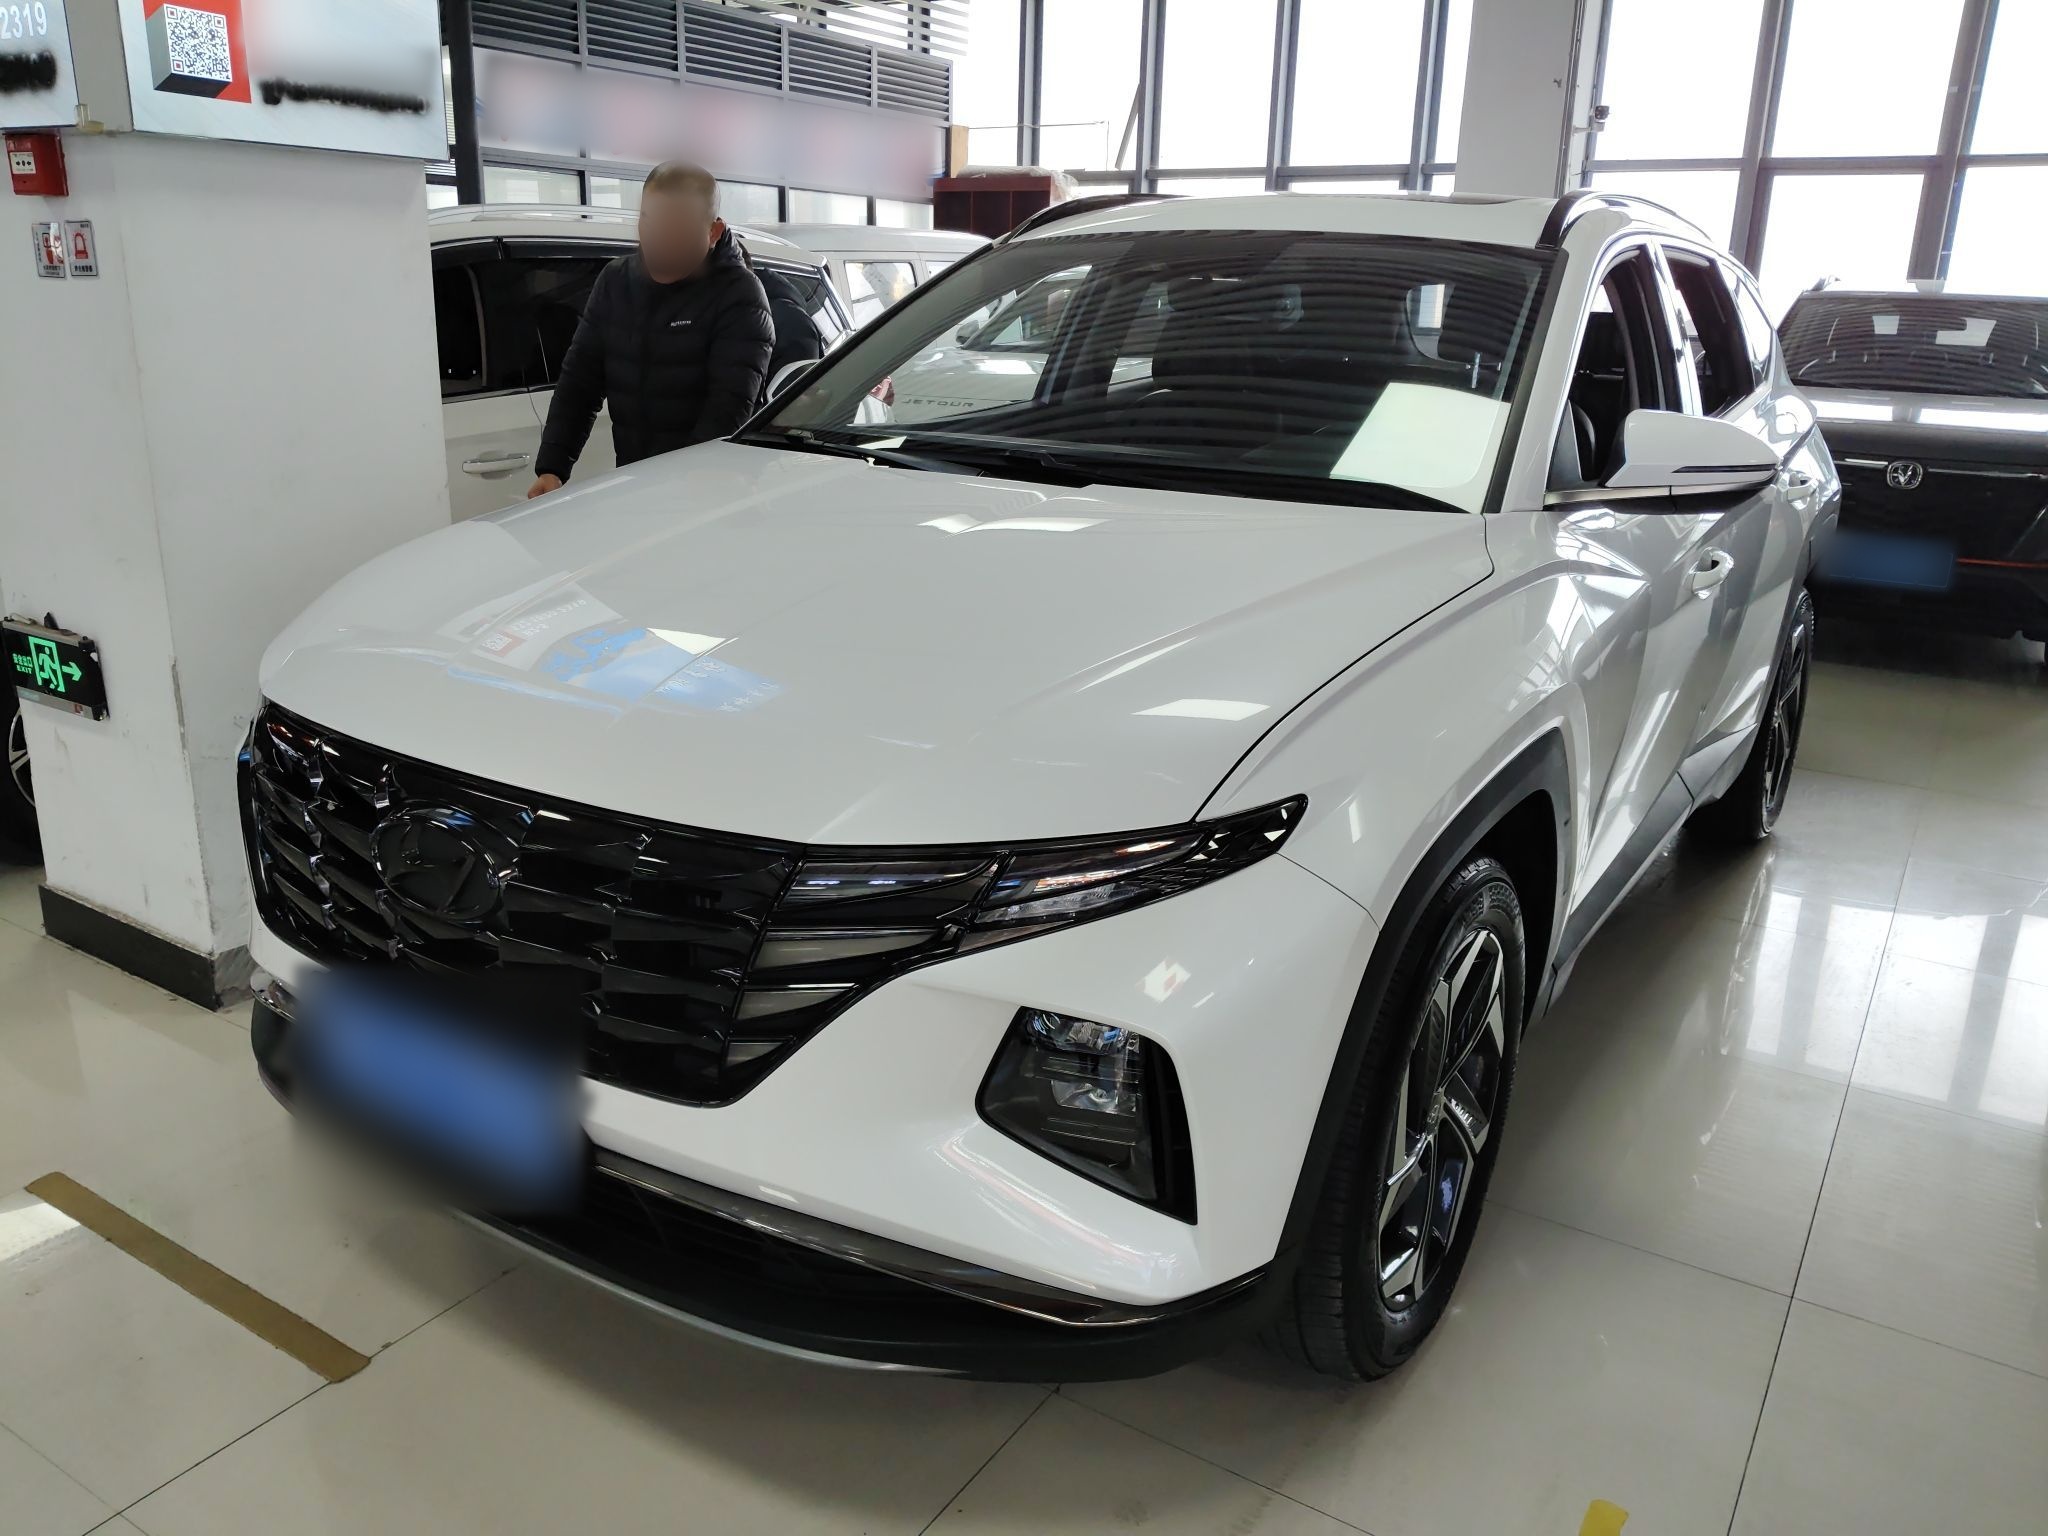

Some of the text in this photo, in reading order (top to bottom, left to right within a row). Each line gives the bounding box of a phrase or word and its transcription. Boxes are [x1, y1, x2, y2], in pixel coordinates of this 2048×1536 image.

[0, 1, 47, 39] 2319
[902, 398, 974, 408] JETOUR
[16, 664, 32, 674] EXIT
